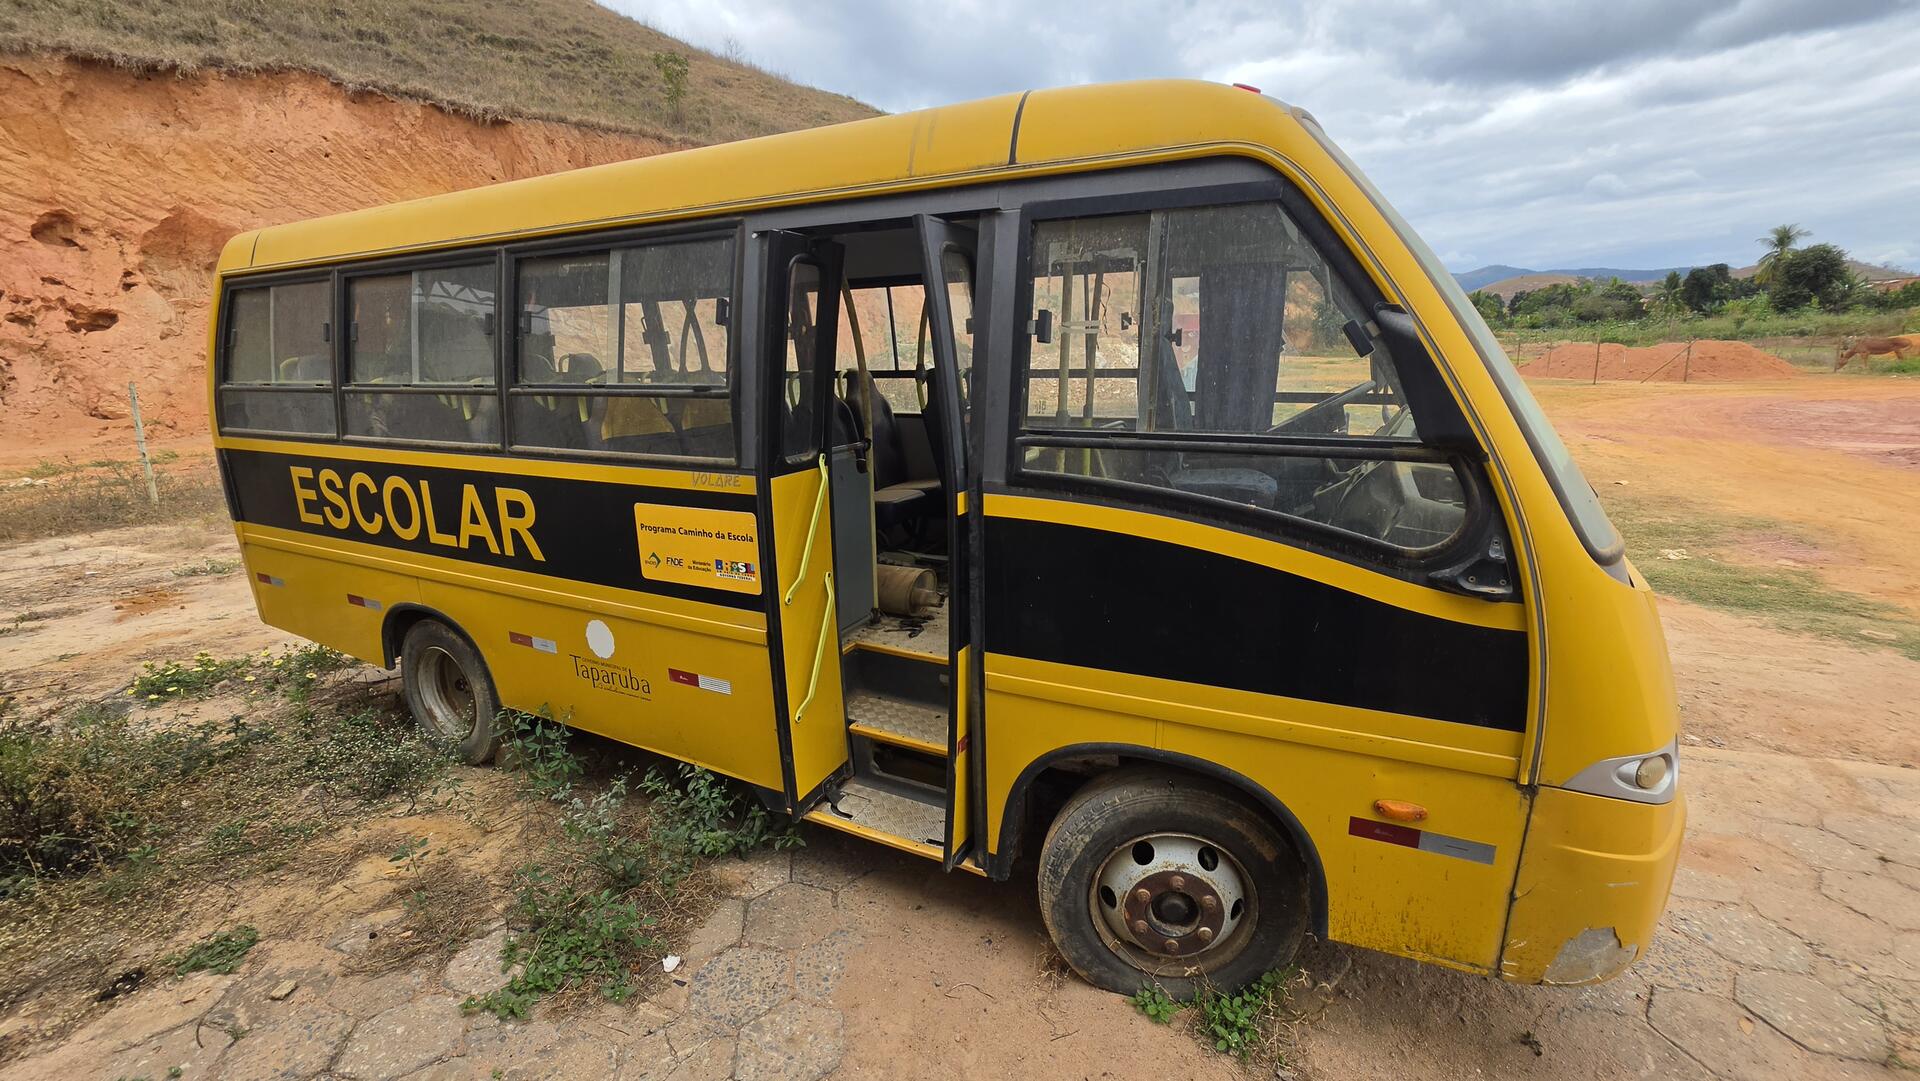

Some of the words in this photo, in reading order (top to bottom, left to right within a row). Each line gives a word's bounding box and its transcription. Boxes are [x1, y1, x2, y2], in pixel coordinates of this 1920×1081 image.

[692, 472, 741, 488] VOLARE
[289, 465, 546, 562] ESCOLAR
[640, 523, 677, 535] Programa
[678, 527, 713, 538] Caminho
[715, 531, 725, 540] da
[727, 532, 754, 543] Escola
[666, 556, 684, 567] FNDE
[569, 654, 651, 694] Taparuba
